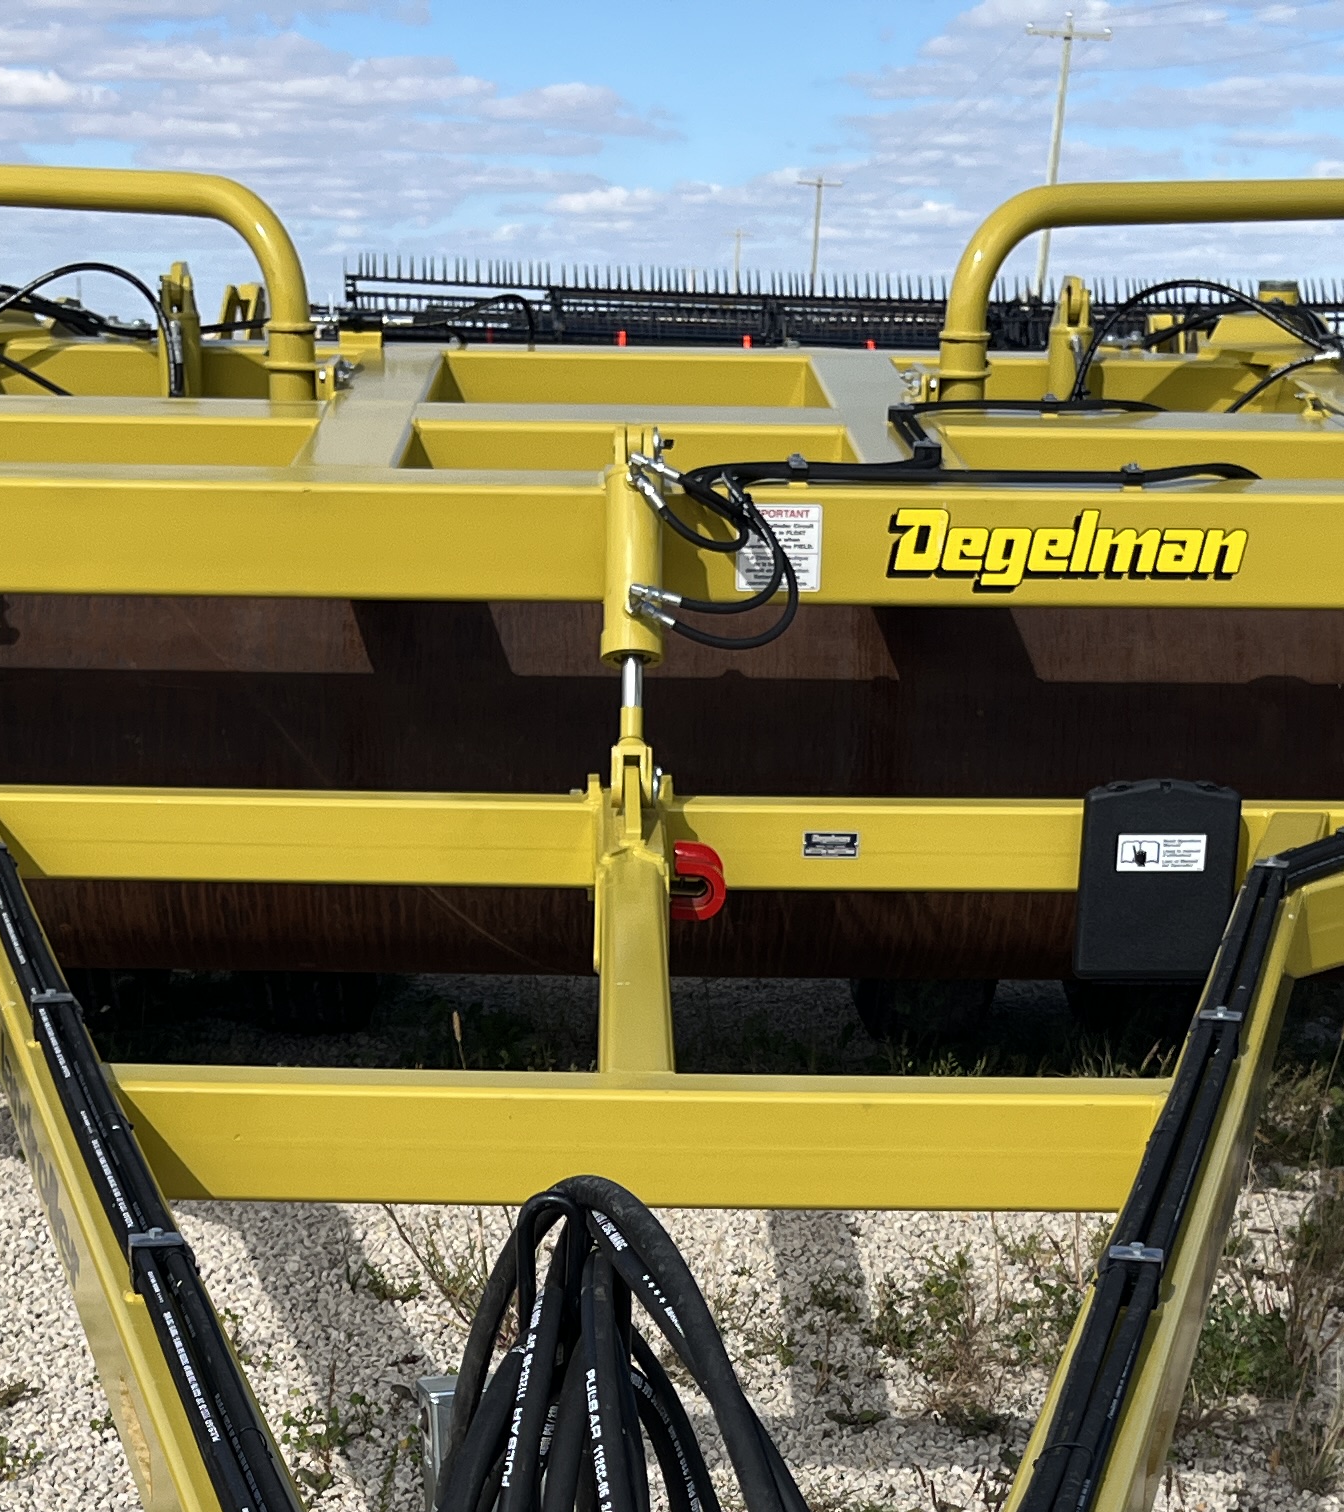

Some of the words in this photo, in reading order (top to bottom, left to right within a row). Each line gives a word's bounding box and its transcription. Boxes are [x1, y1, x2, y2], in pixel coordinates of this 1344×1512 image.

[758, 509, 810, 519] PORTANT
[886, 507, 1249, 594] Degelman
[585, 1368, 602, 1440] PULSAR
[592, 1444, 610, 1499] 112CC-06
